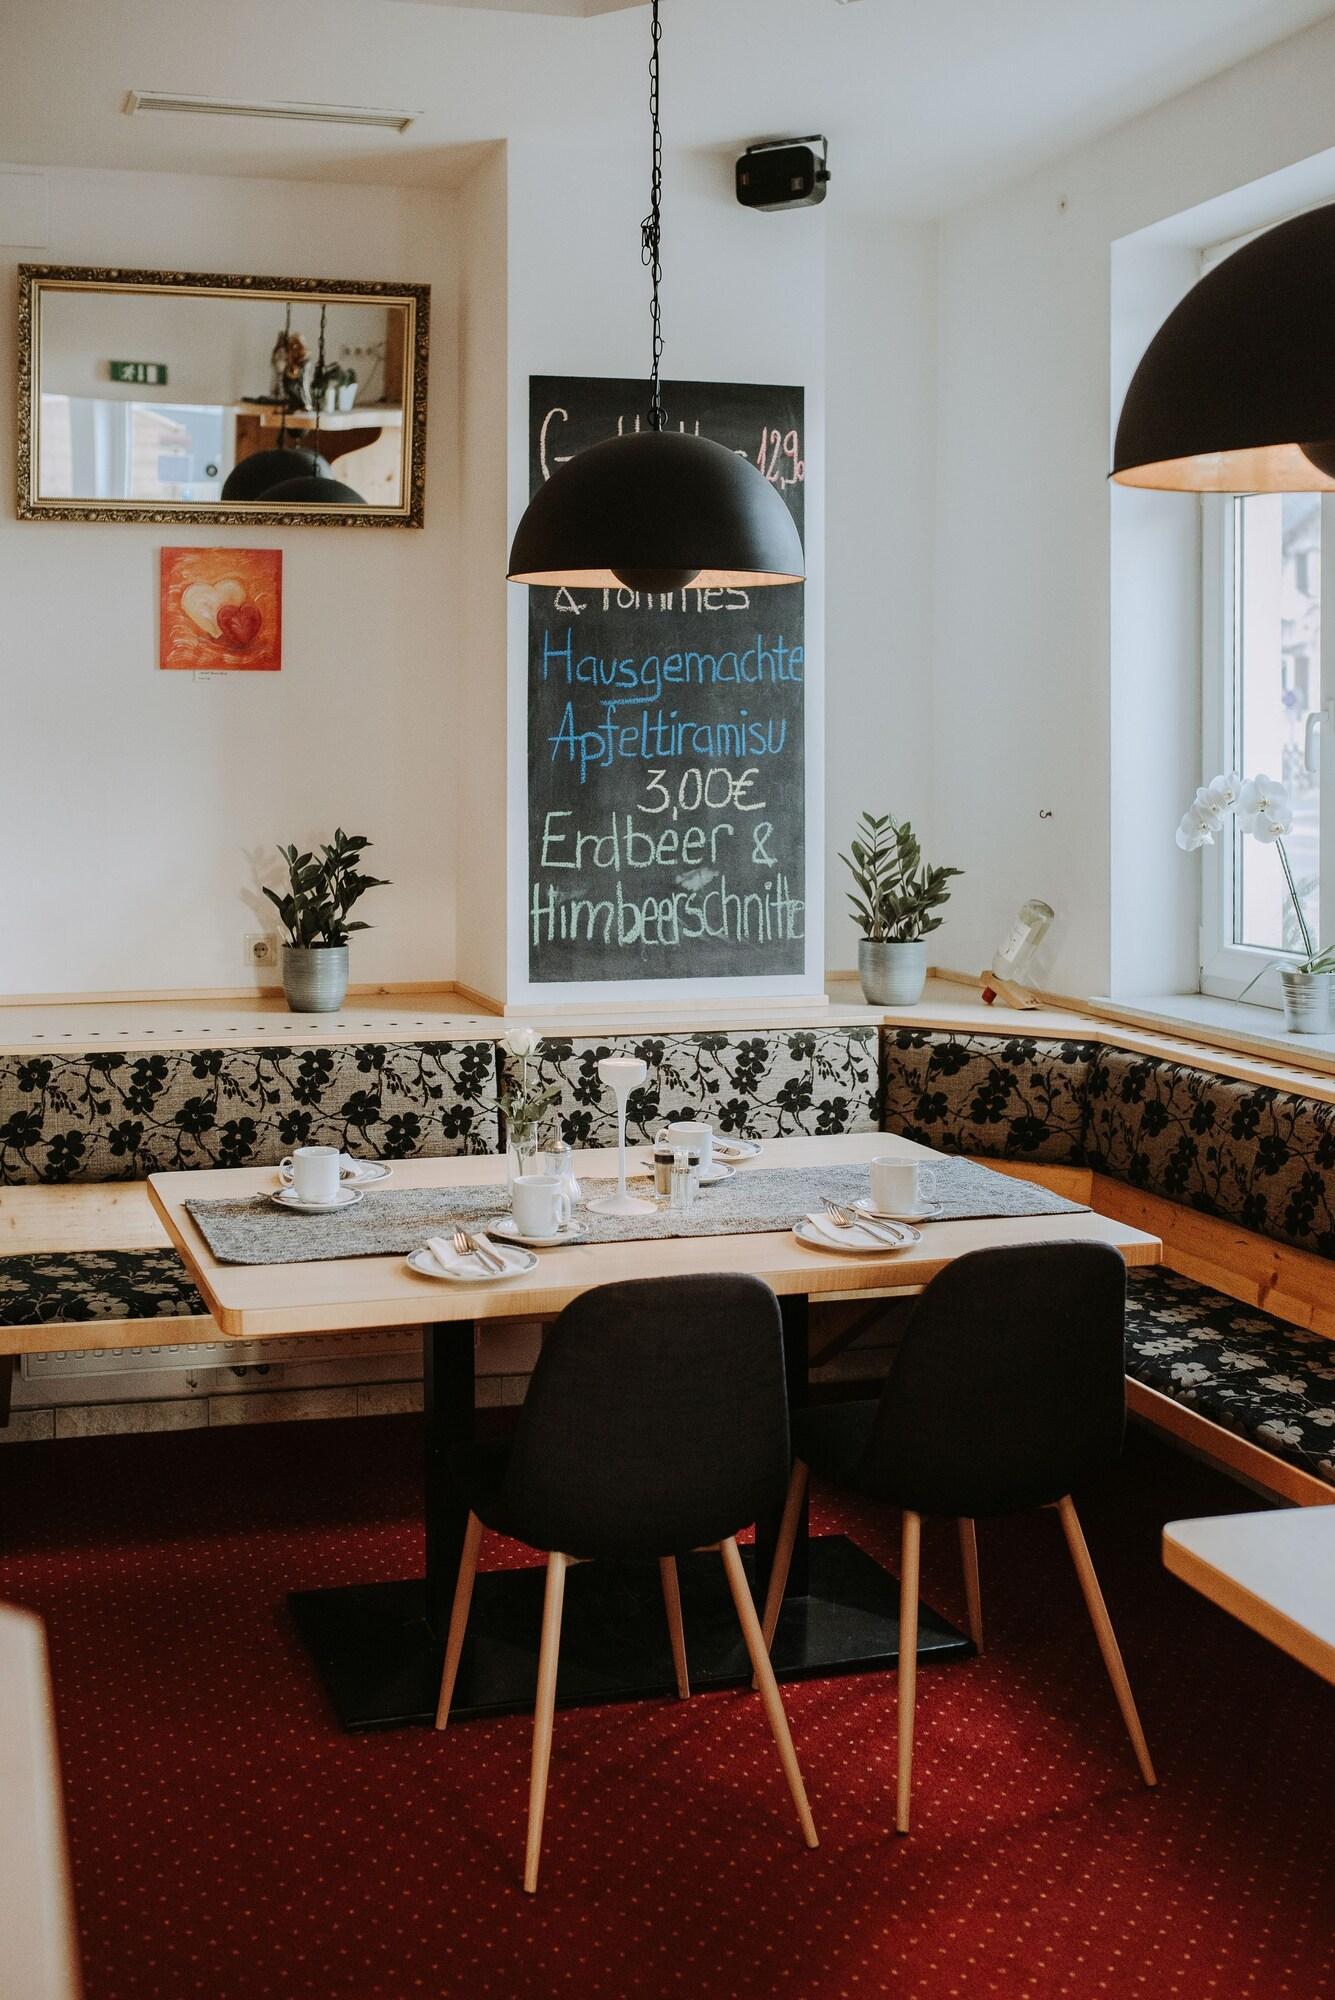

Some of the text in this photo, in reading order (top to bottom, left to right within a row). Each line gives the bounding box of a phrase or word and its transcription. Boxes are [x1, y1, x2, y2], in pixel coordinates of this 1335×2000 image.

[543, 627, 804, 704] Hausgemachte
[548, 701, 787, 784] Apfeltiramisu
[637, 767, 766, 820] 3,00€
[540, 811, 778, 872] Erdbeer &
[530, 872, 804, 946] Himbeerschnitte
